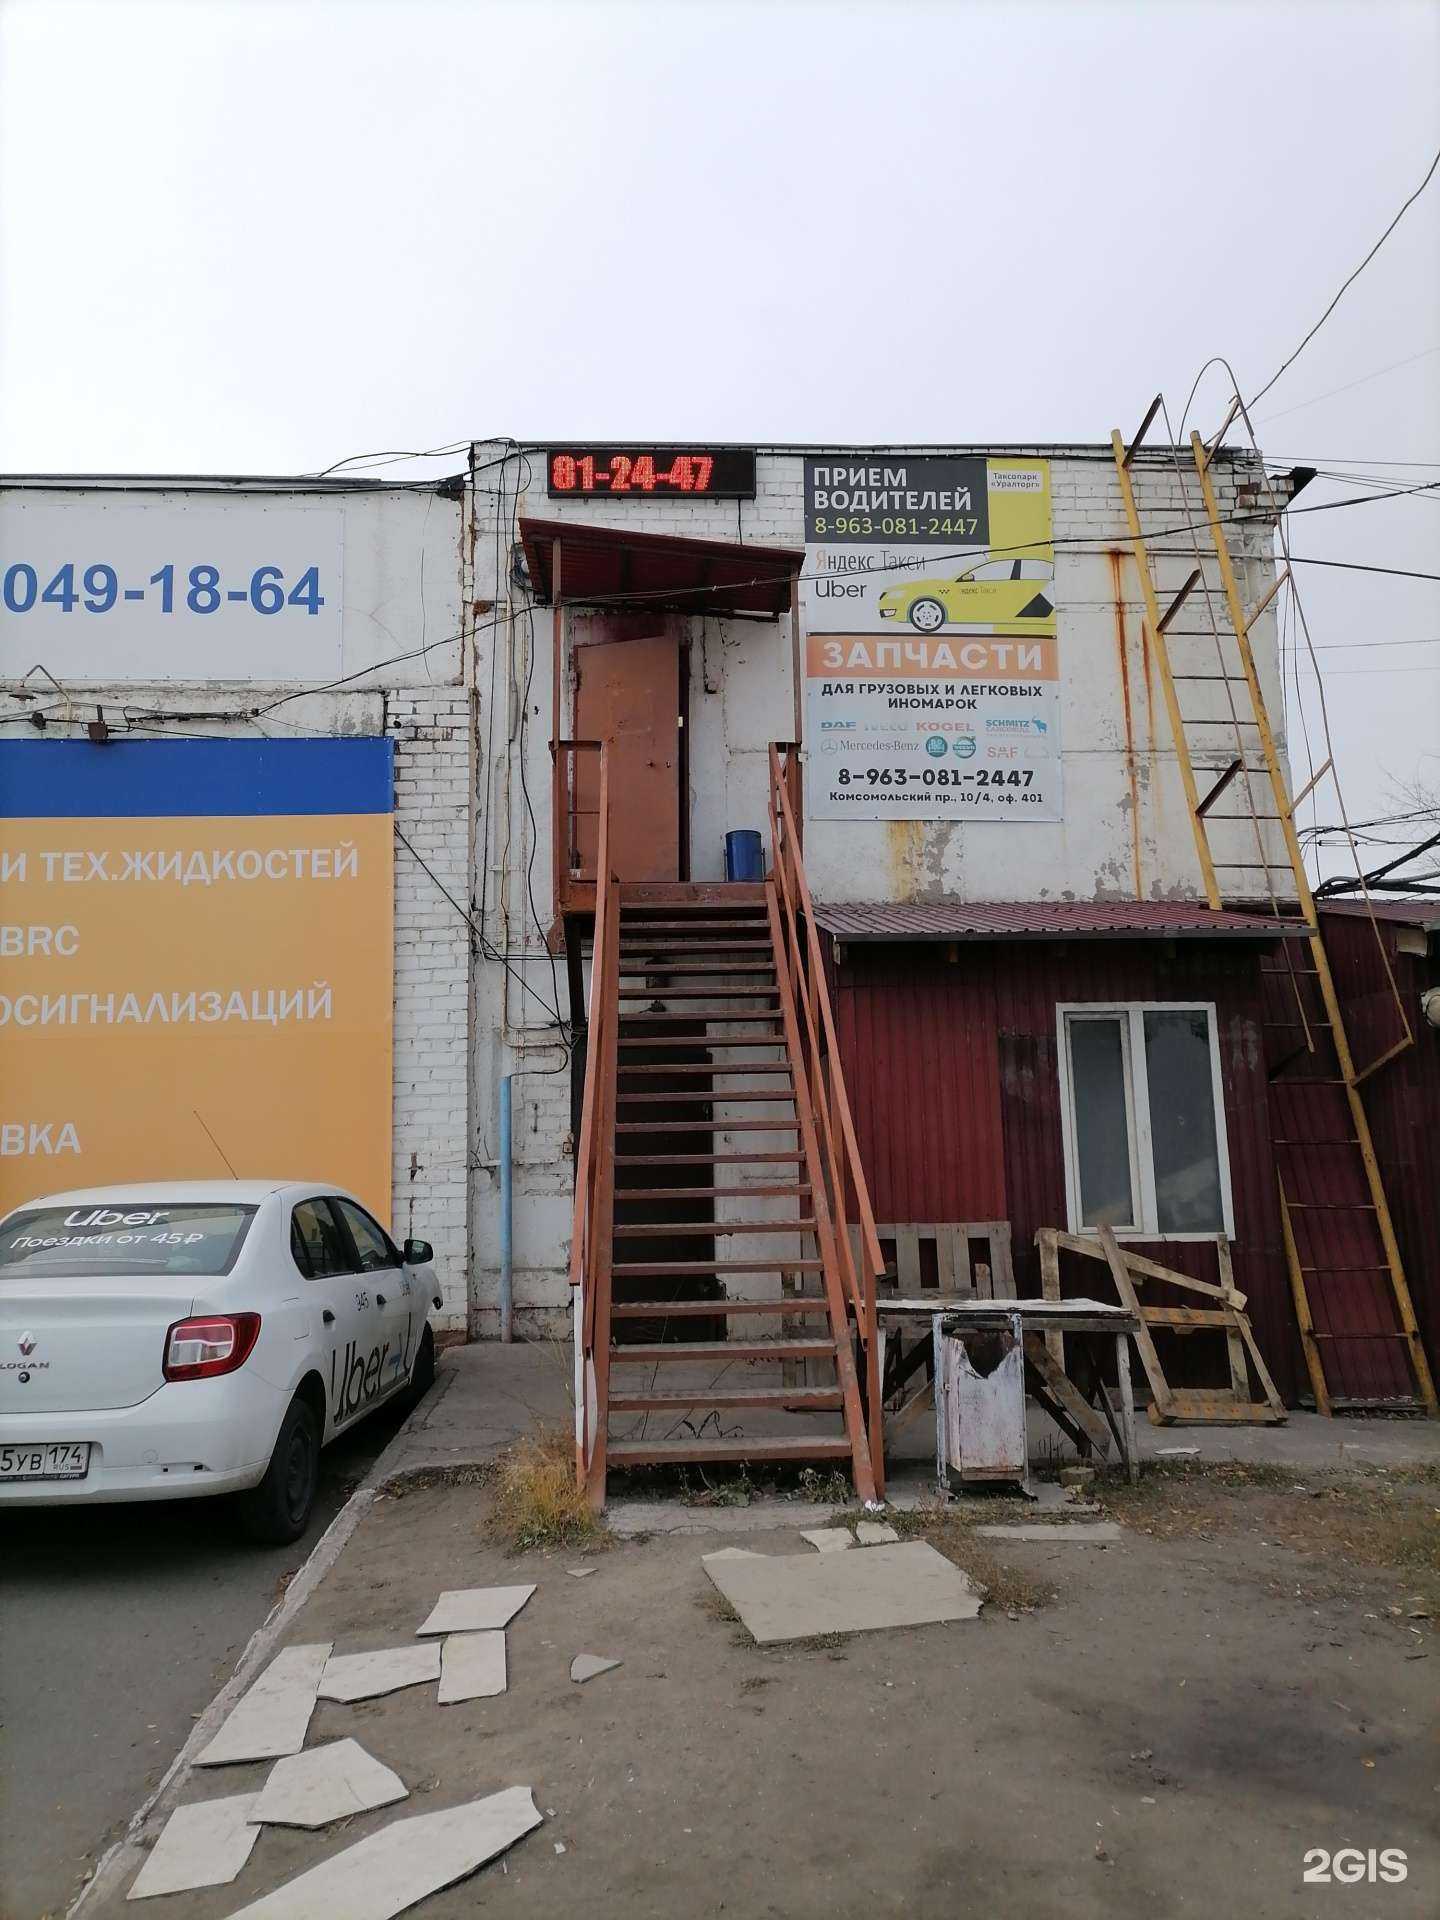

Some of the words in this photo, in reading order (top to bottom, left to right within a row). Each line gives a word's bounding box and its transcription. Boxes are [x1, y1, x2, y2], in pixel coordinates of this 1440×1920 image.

[553, 455, 714, 491] 81-24-47
[814, 468, 907, 486] ПРИЕМ
[994, 472, 1037, 481] Таксопарк
[814, 487, 972, 512] ВОДИТЕЛЕЙ
[815, 517, 978, 535] 8-963-081-2447
[816, 550, 875, 571] Яндекс
[880, 551, 926, 571] Такси
[3, 563, 325, 615] 049-18-64
[815, 580, 867, 598] Uber
[822, 641, 1042, 671] ЗАПЧАСТИ
[821, 683, 853, 696] ДЛЯ
[859, 684, 940, 695] ГРУЗОВЫХ
[945, 685, 955, 695] И
[960, 685, 1043, 697] ЛЕГКОВЫХ
[888, 698, 977, 710] ИНОМАРОК
[821, 721, 857, 729] DAF
[986, 719, 1030, 728] SCHMITZ
[838, 768, 1034, 786] 8-963-081-2447
[829, 791, 930, 802] Комсомольский
[936, 793, 956, 804] пр.,
[960, 793, 994, 803] 10/4,
[998, 792, 1018, 804] оф.
[1022, 793, 1043, 803] 401
[0, 853, 26, 882] И
[40, 841, 359, 886] ТЕХ.ЖИДКОСТЕЙ
[0, 925, 80, 955] BRC
[0, 1123, 81, 1155] ВКА
[63, 1210, 170, 1227] Uber
[9, 1235, 111, 1249] Поездки
[116, 1236, 147, 1244] от
[0, 1362, 50, 1370] LOGAN
[48, 1446, 81, 1465] 174
